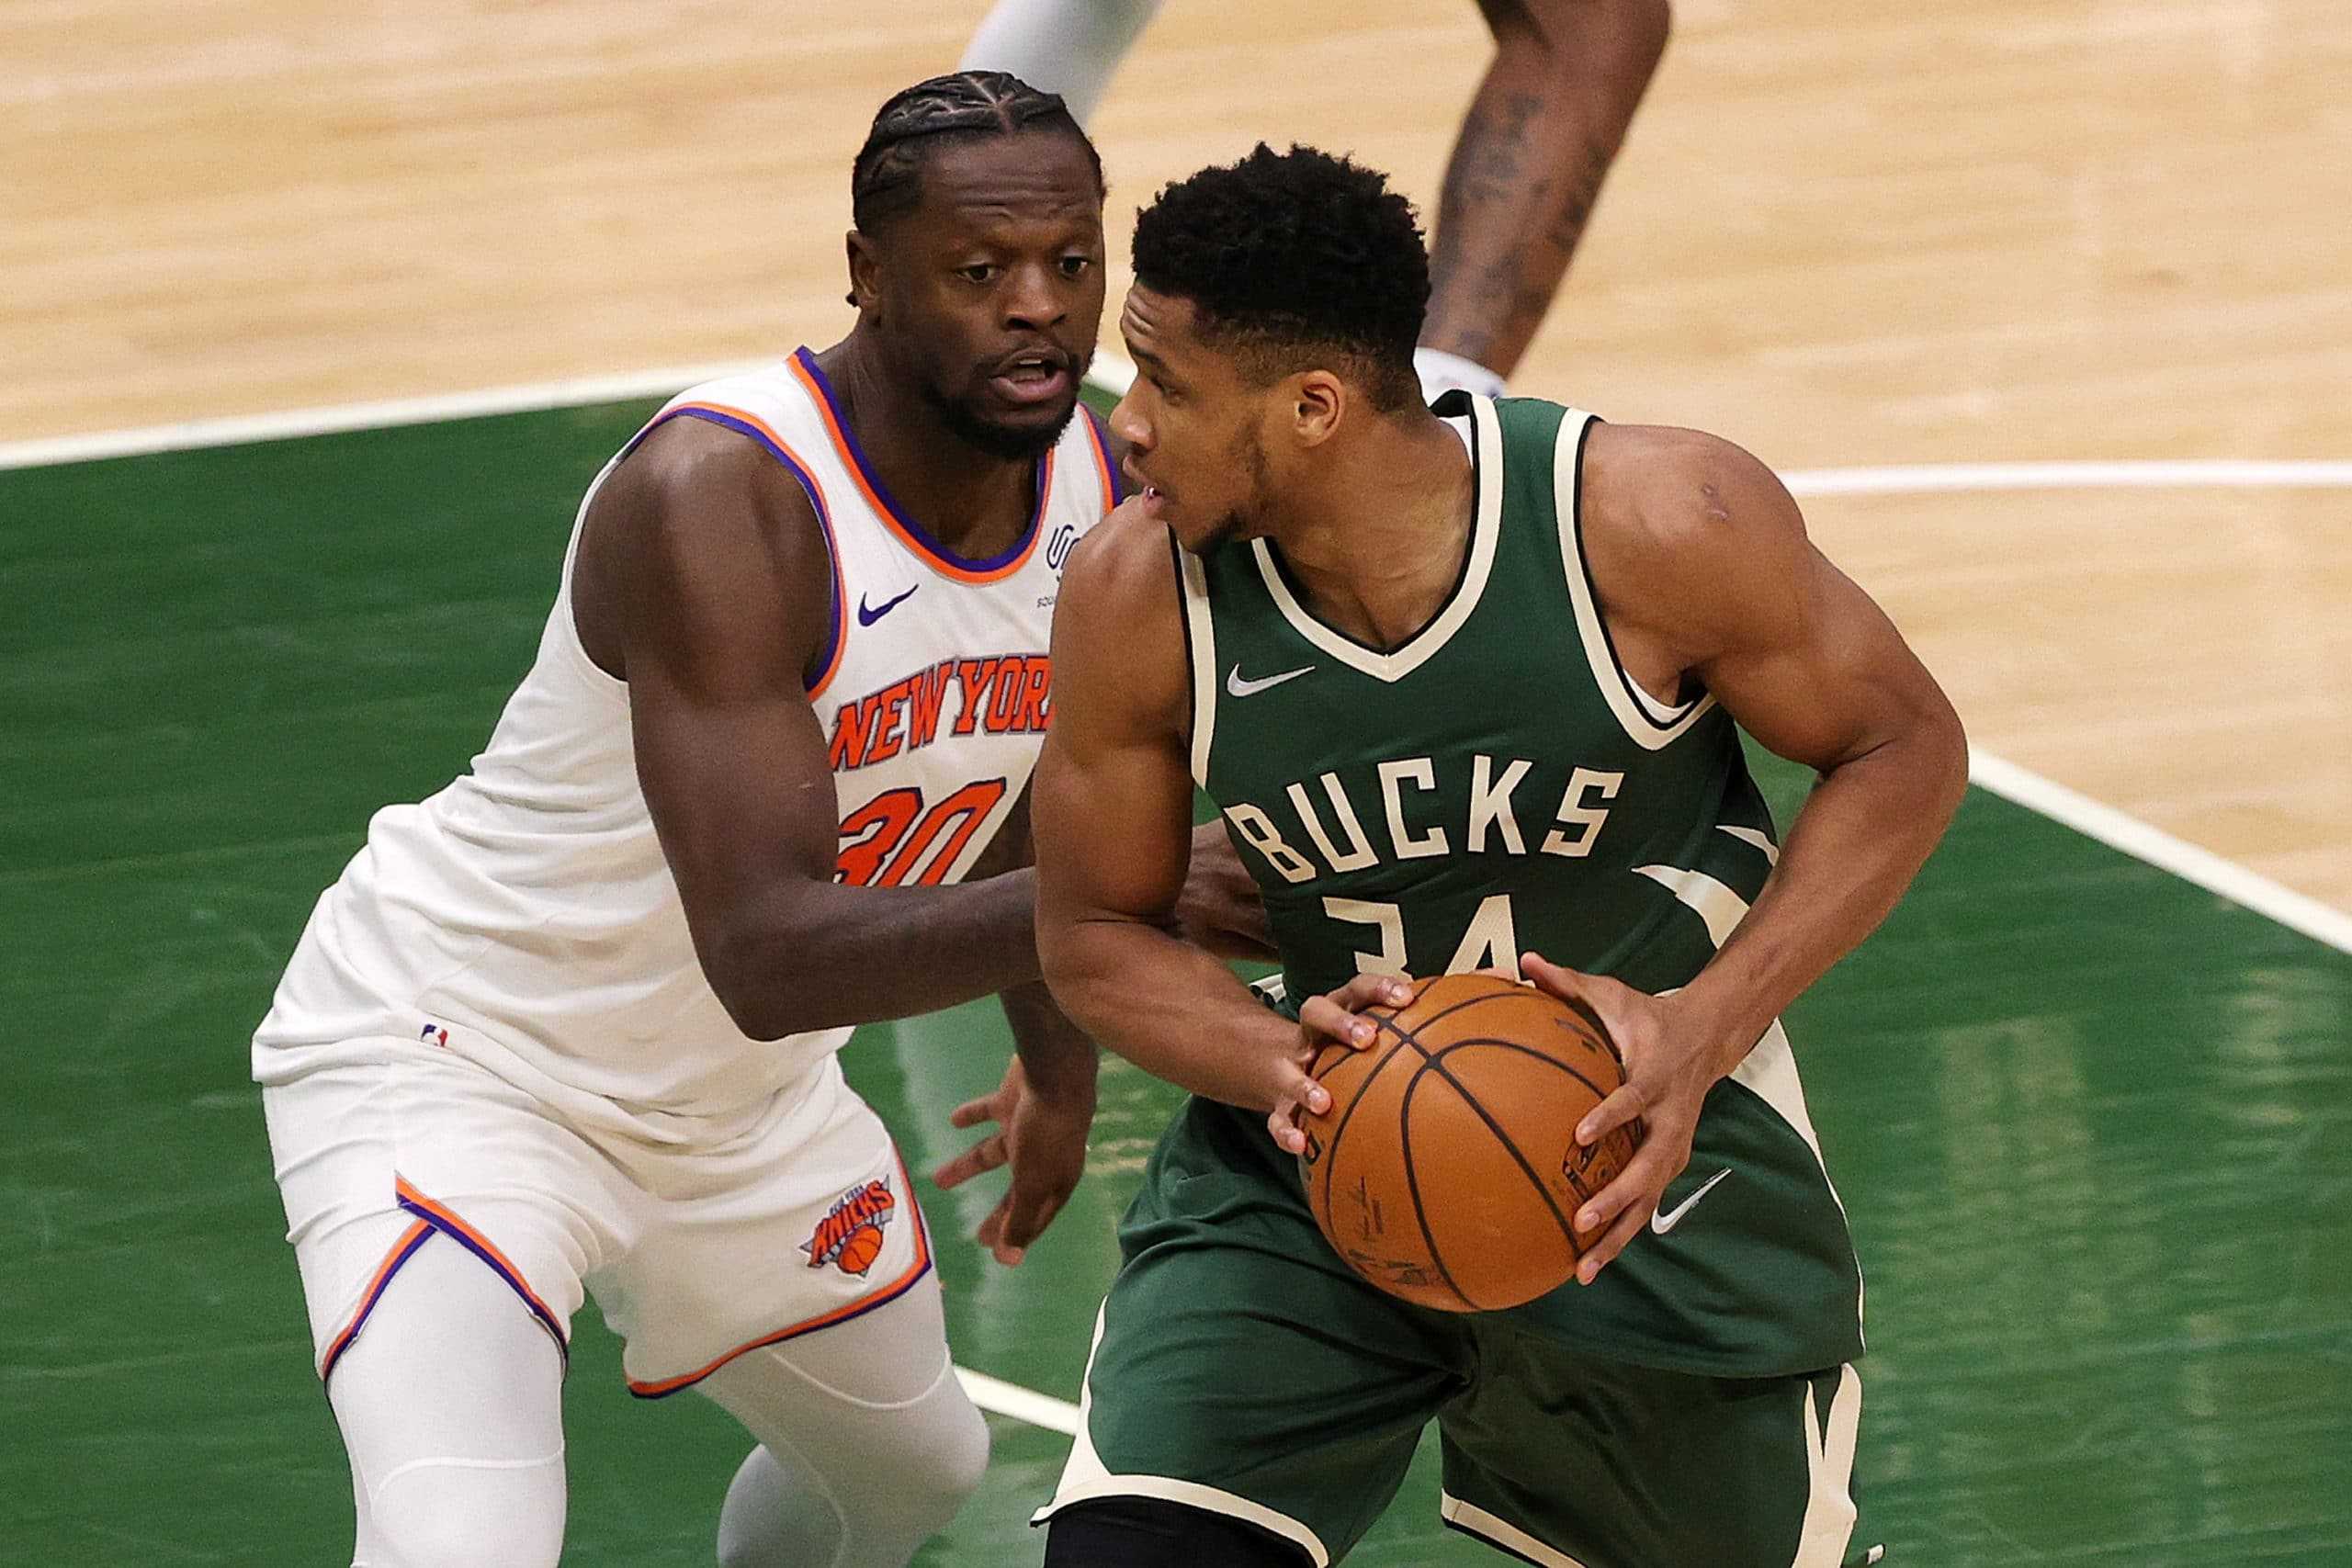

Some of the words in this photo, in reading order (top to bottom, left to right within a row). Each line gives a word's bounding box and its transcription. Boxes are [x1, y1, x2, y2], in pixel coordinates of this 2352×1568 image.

[830, 661, 953, 772] NEW
[952, 653, 1057, 736] YOR
[1223, 754, 1625, 883] BUCKS
[808, 1179, 895, 1269] KNICKS
